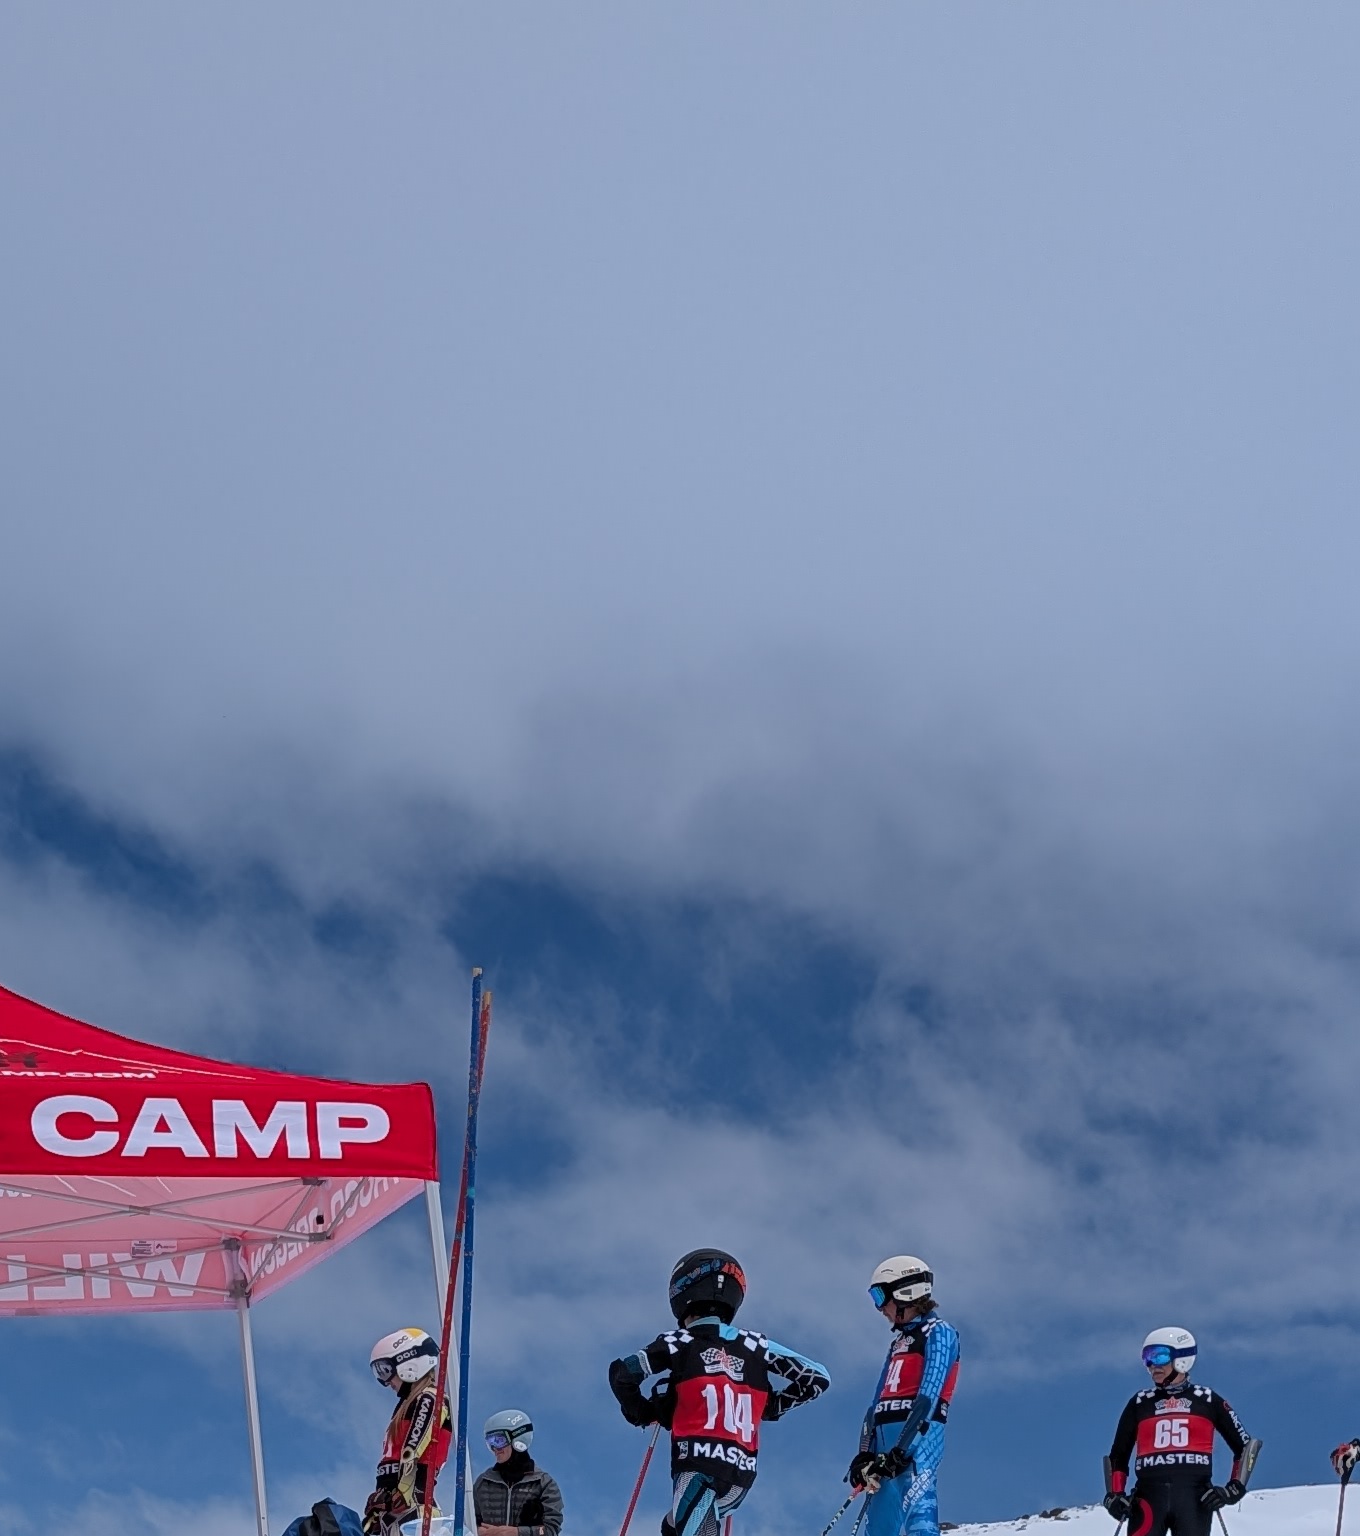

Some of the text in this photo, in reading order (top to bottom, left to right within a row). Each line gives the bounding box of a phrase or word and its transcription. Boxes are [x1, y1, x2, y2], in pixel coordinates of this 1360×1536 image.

[30, 1094, 391, 1160] CAMP
[407, 1397, 433, 1447] KARBON
[874, 1399, 915, 1415] STER
[1153, 1418, 1190, 1449] 65
[693, 1442, 757, 1472] MASTER
[1143, 1453, 1210, 1467] MASTERS
